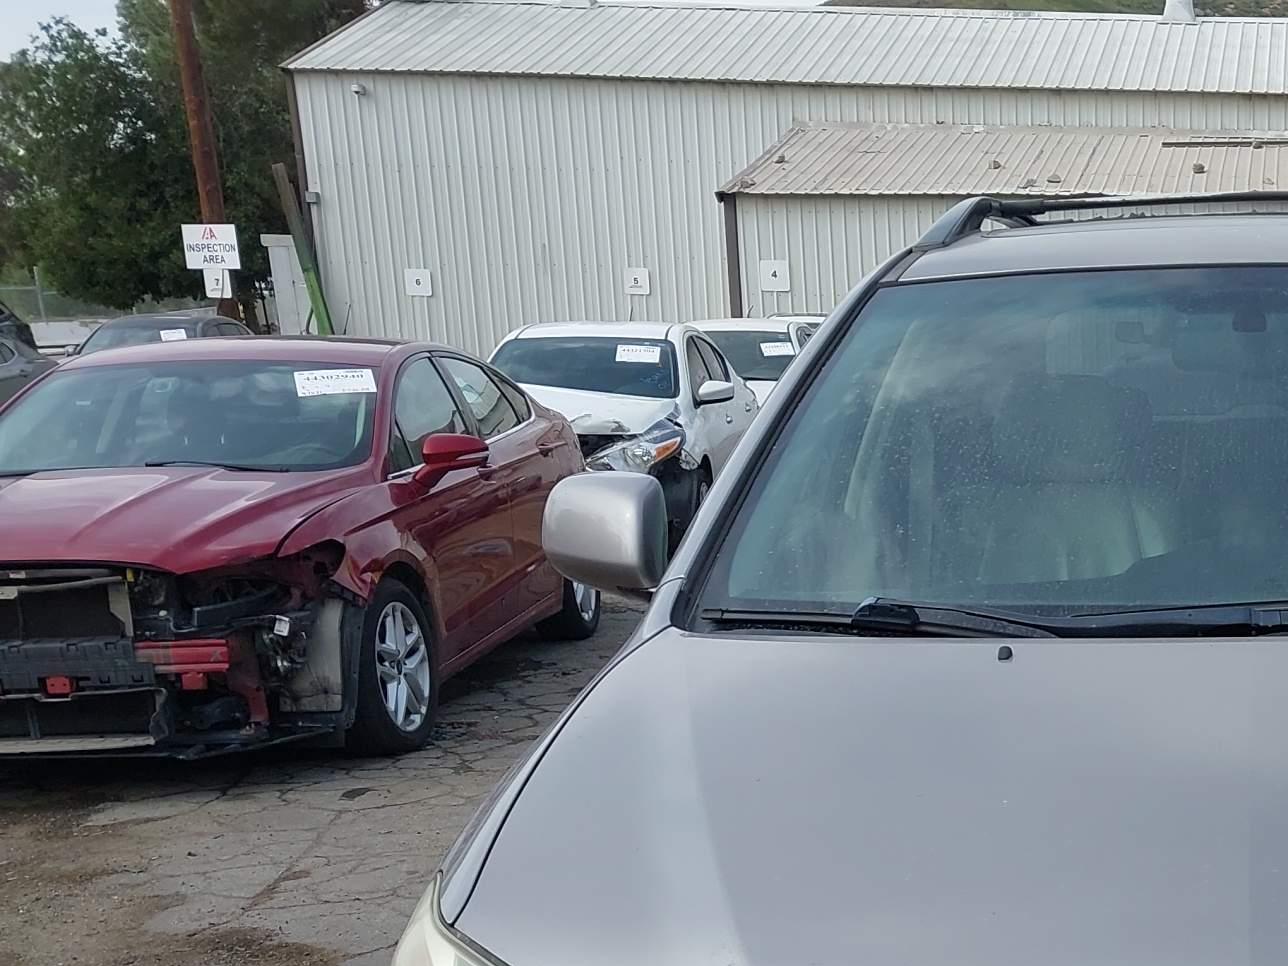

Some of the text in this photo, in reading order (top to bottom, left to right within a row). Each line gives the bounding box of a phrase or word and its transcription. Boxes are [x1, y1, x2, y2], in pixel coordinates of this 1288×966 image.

[186, 243, 236, 253] INSPECTION
[202, 254, 226, 265] AREA
[771, 270, 778, 279] 4
[213, 278, 220, 287] 7
[415, 278, 422, 286] 6
[633, 277, 639, 285] 5
